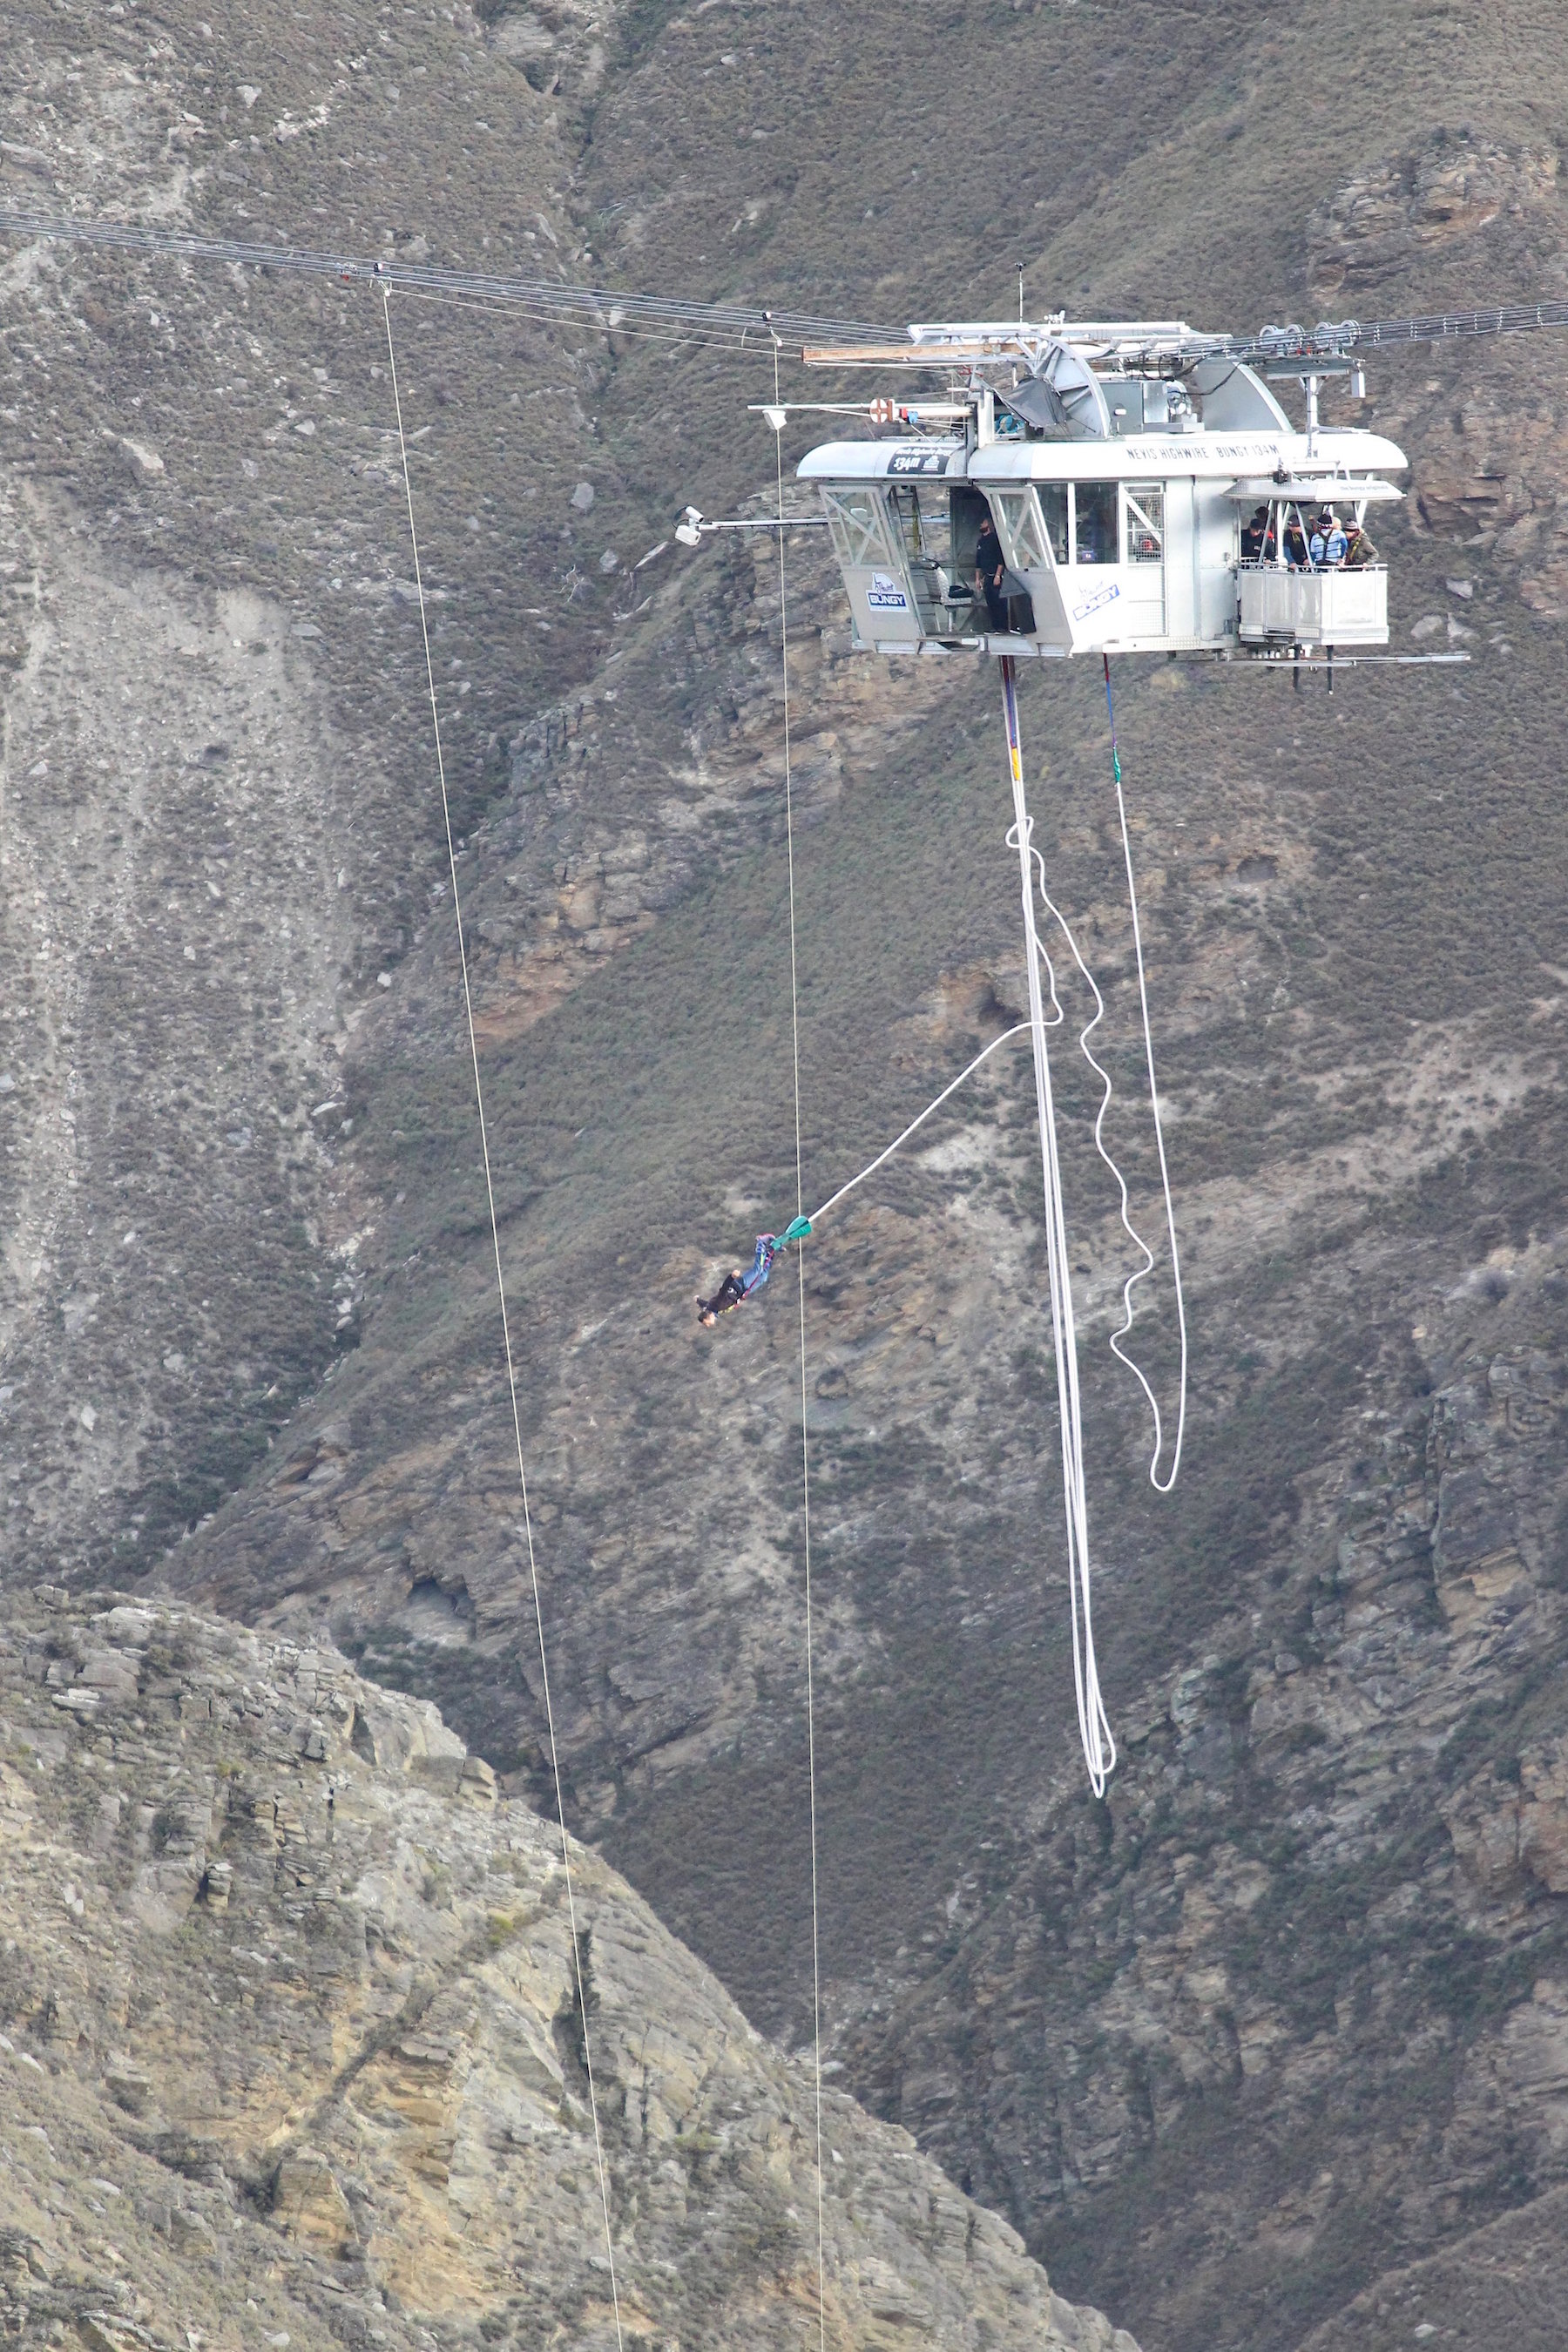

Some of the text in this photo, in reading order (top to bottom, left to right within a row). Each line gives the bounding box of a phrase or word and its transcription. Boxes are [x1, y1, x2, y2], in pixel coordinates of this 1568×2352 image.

[1126, 444, 1281, 460] NEVIS HIGHWIRE BUNGY 134M
[869, 594, 902, 605] BUNGY
